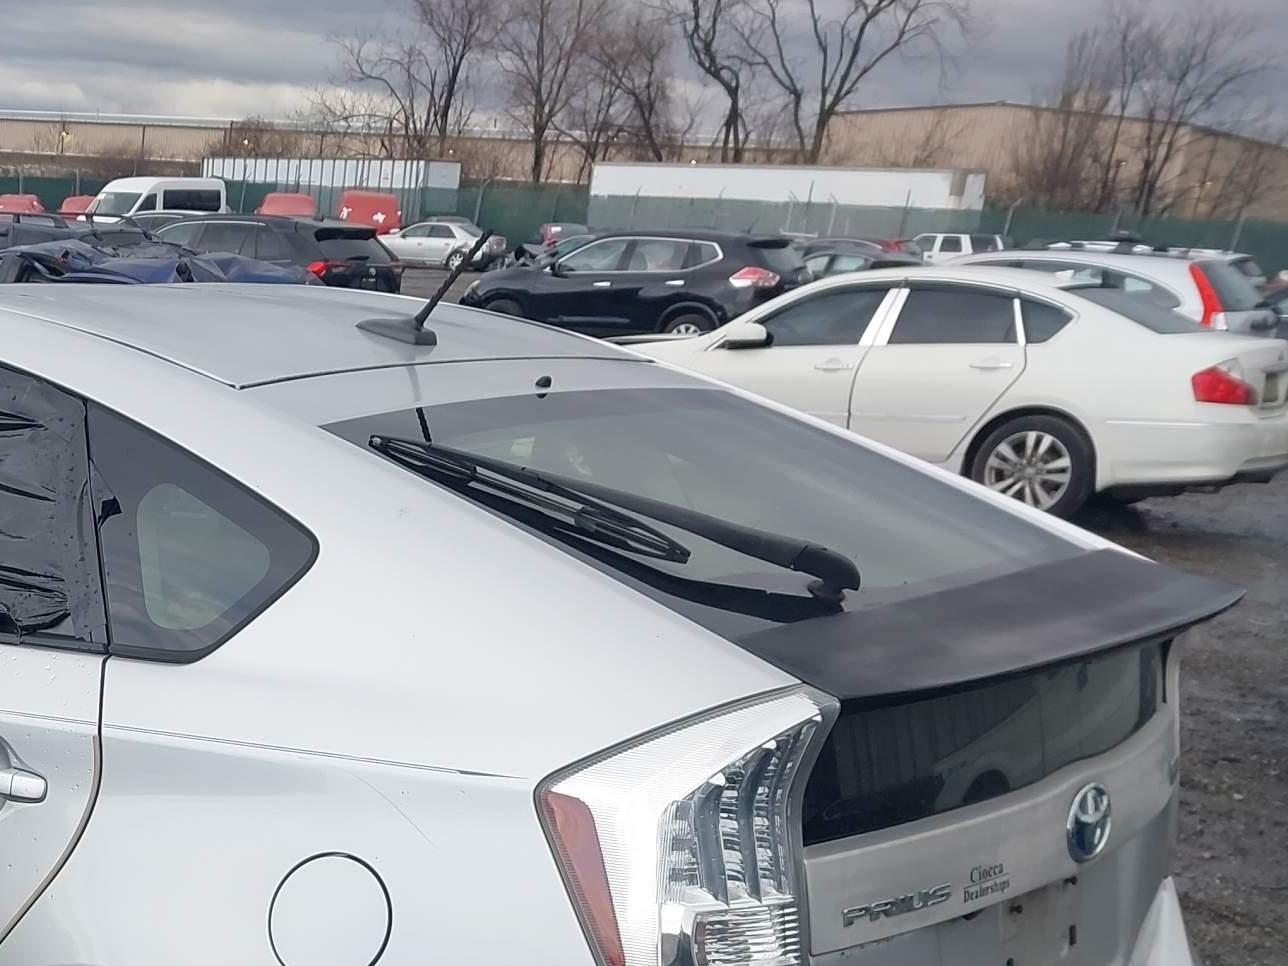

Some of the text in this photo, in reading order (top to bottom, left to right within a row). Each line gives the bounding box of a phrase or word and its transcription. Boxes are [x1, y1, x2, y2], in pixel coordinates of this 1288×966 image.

[969, 863, 1004, 883] Ciocca
[962, 878, 1010, 904] Dealerships
[841, 882, 953, 928] PRIUS
